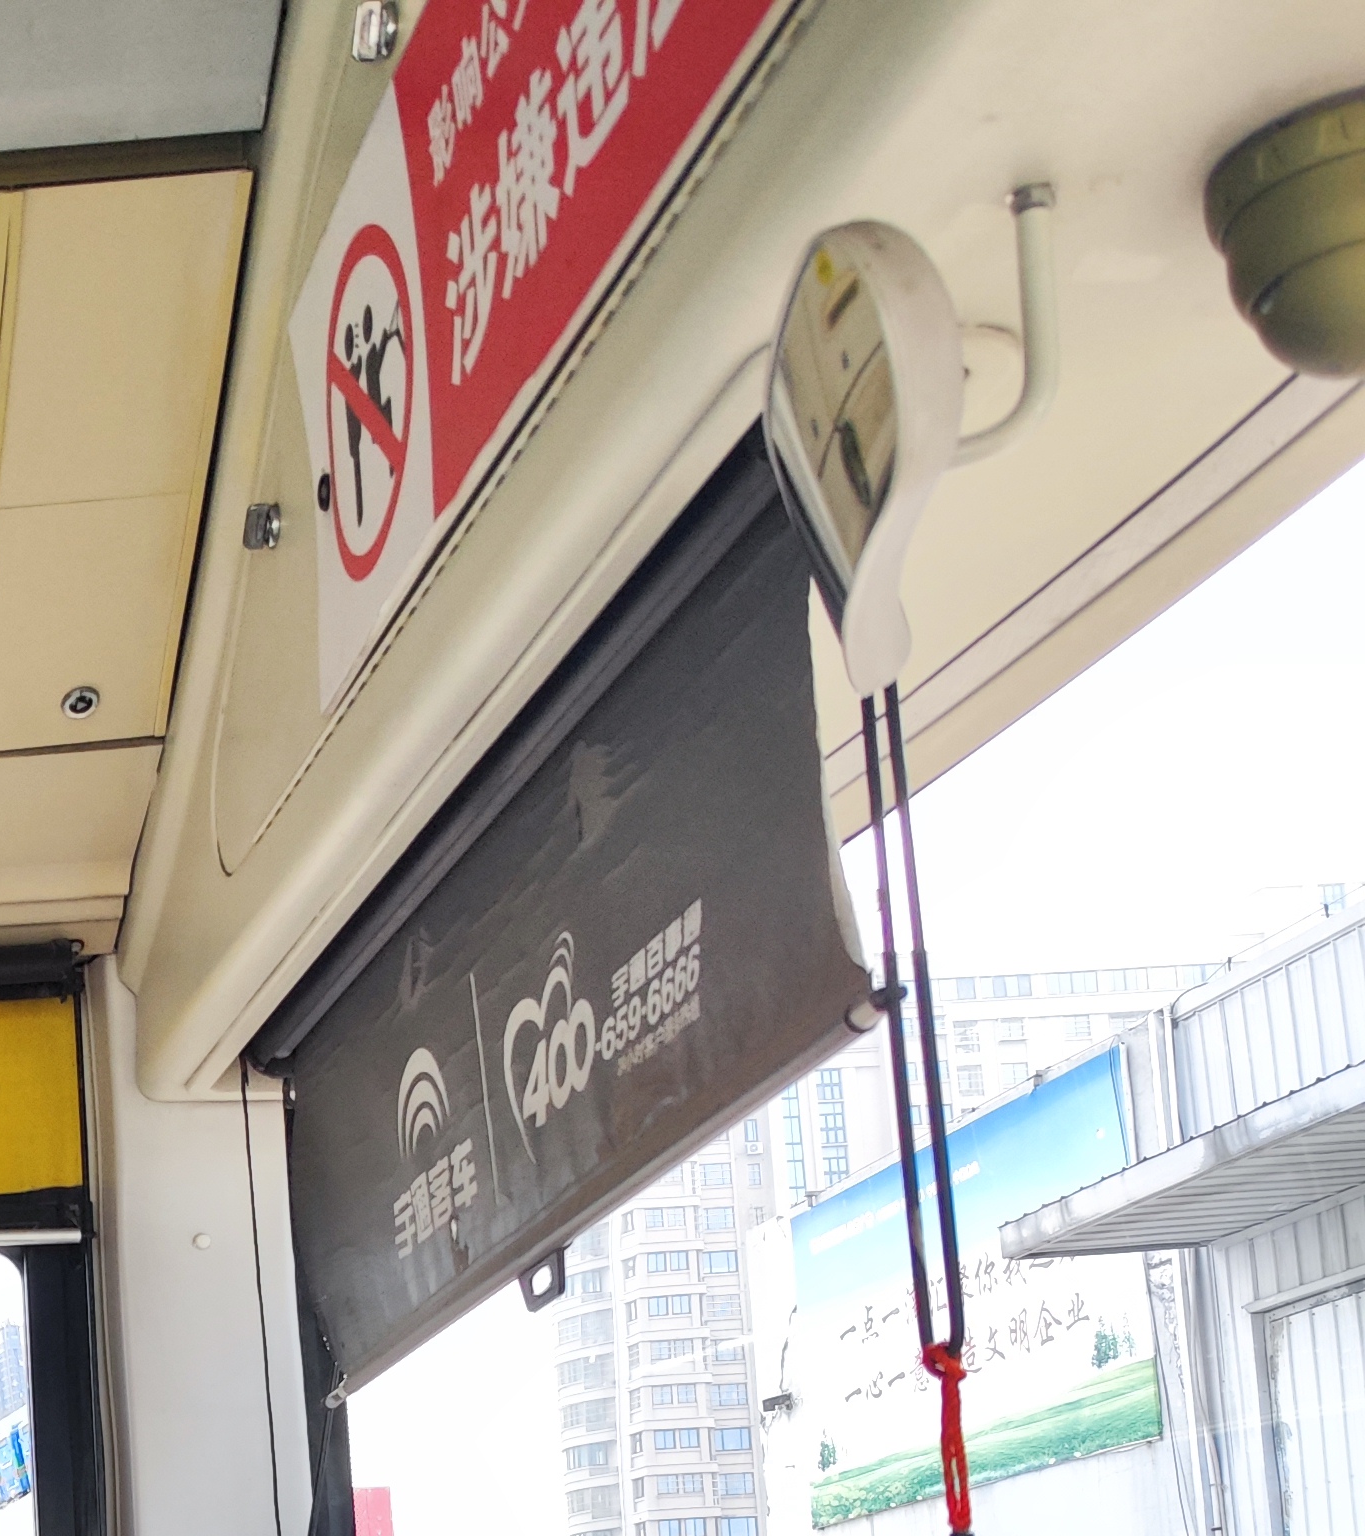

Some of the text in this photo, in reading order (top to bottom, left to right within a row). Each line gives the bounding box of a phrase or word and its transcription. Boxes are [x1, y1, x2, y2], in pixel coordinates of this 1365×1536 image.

[427, 0, 527, 188] 影响公
[393, 1137, 477, 1260] 宇通客车
[844, 1292, 1091, 1403] 一心一意造文明企业
